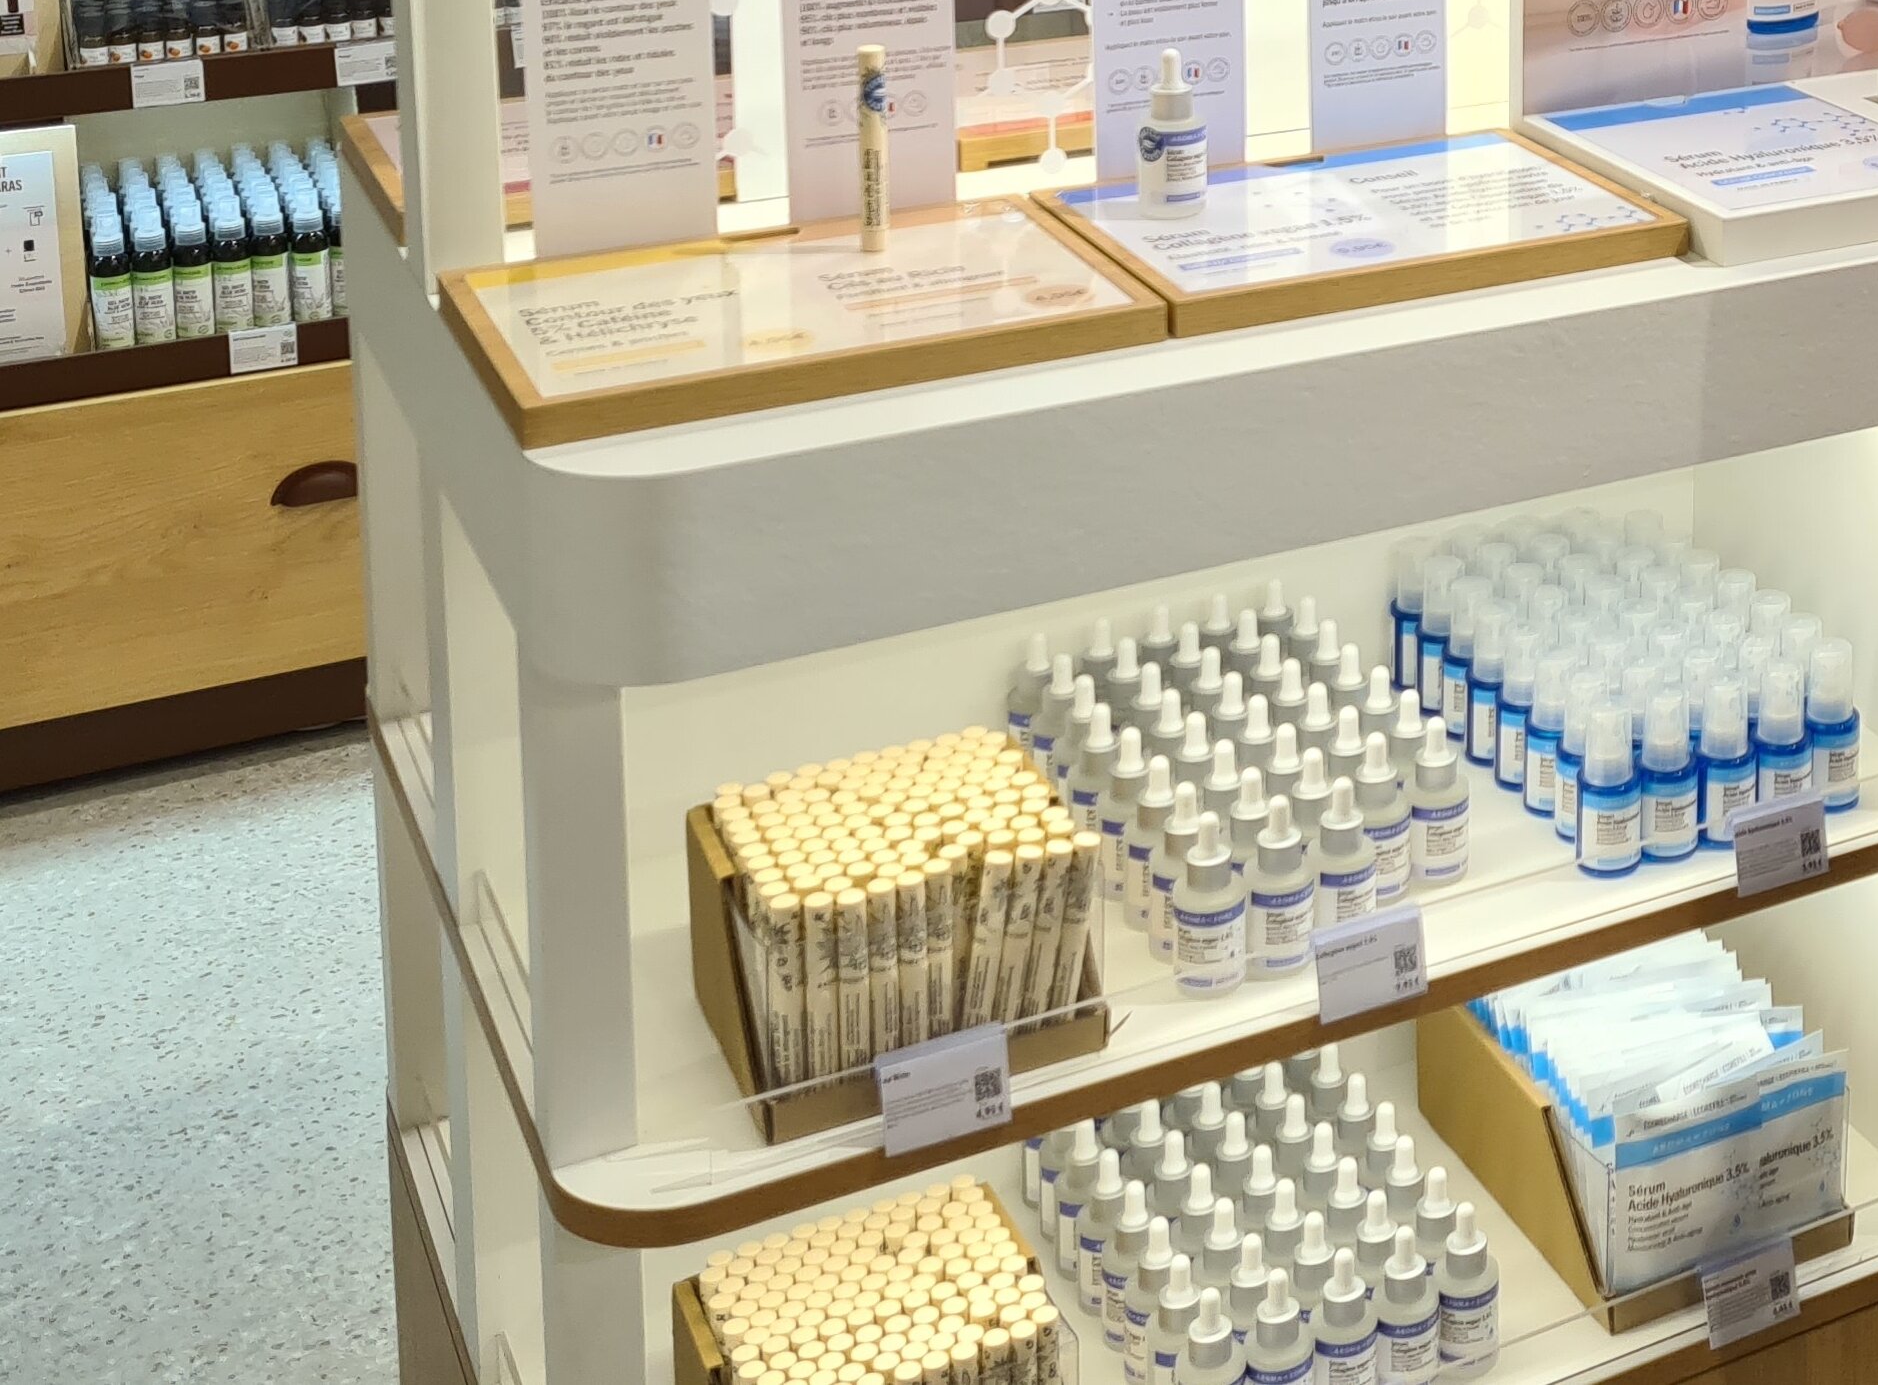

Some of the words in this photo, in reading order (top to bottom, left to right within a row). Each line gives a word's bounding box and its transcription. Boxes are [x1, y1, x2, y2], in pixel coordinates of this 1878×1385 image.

[1628, 1180, 1666, 1198] Sérum
[1628, 1195, 1659, 1213] Acide
[1661, 1173, 1724, 1206] Hyaluronique
